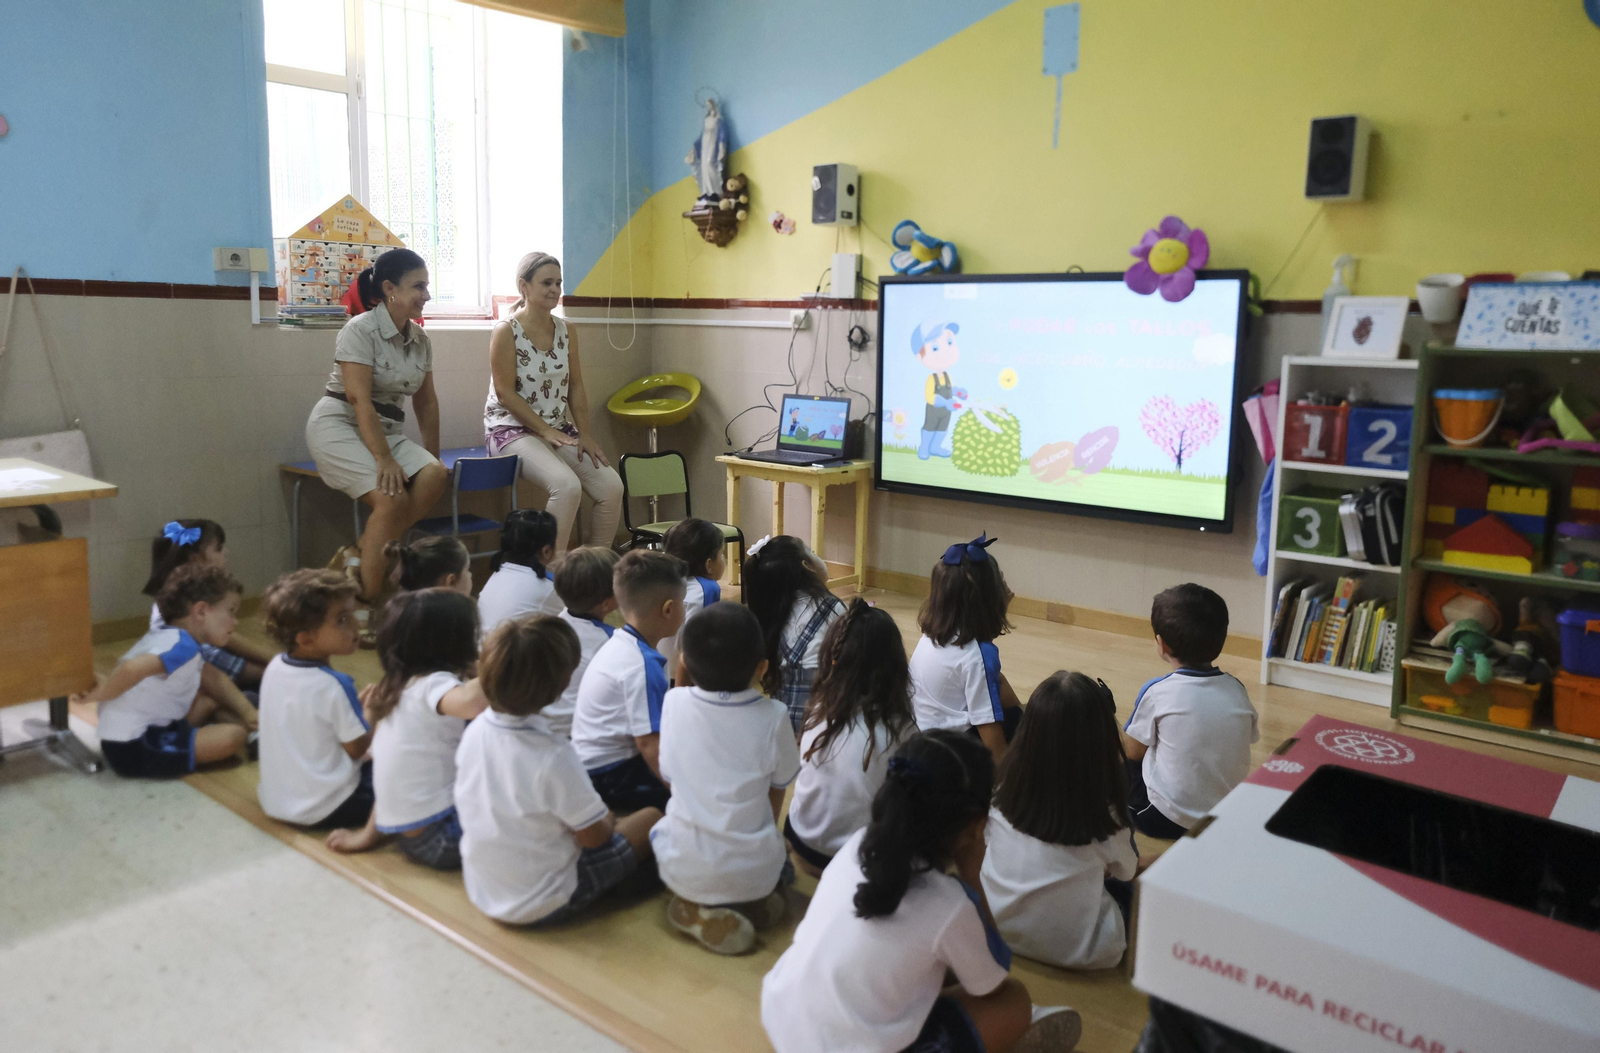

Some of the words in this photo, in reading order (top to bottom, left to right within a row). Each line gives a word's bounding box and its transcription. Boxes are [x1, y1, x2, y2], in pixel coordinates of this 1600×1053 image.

[1009, 316, 1076, 335] PODAR
[1085, 321, 1118, 337] LOS
[1128, 318, 1211, 338] TALLOS
[1504, 317, 1561, 335] CUENTAS
[1301, 413, 1326, 459] 1
[1362, 418, 1397, 466] 2
[1293, 506, 1321, 549] 3
[1254, 973, 1315, 1012] PARA
